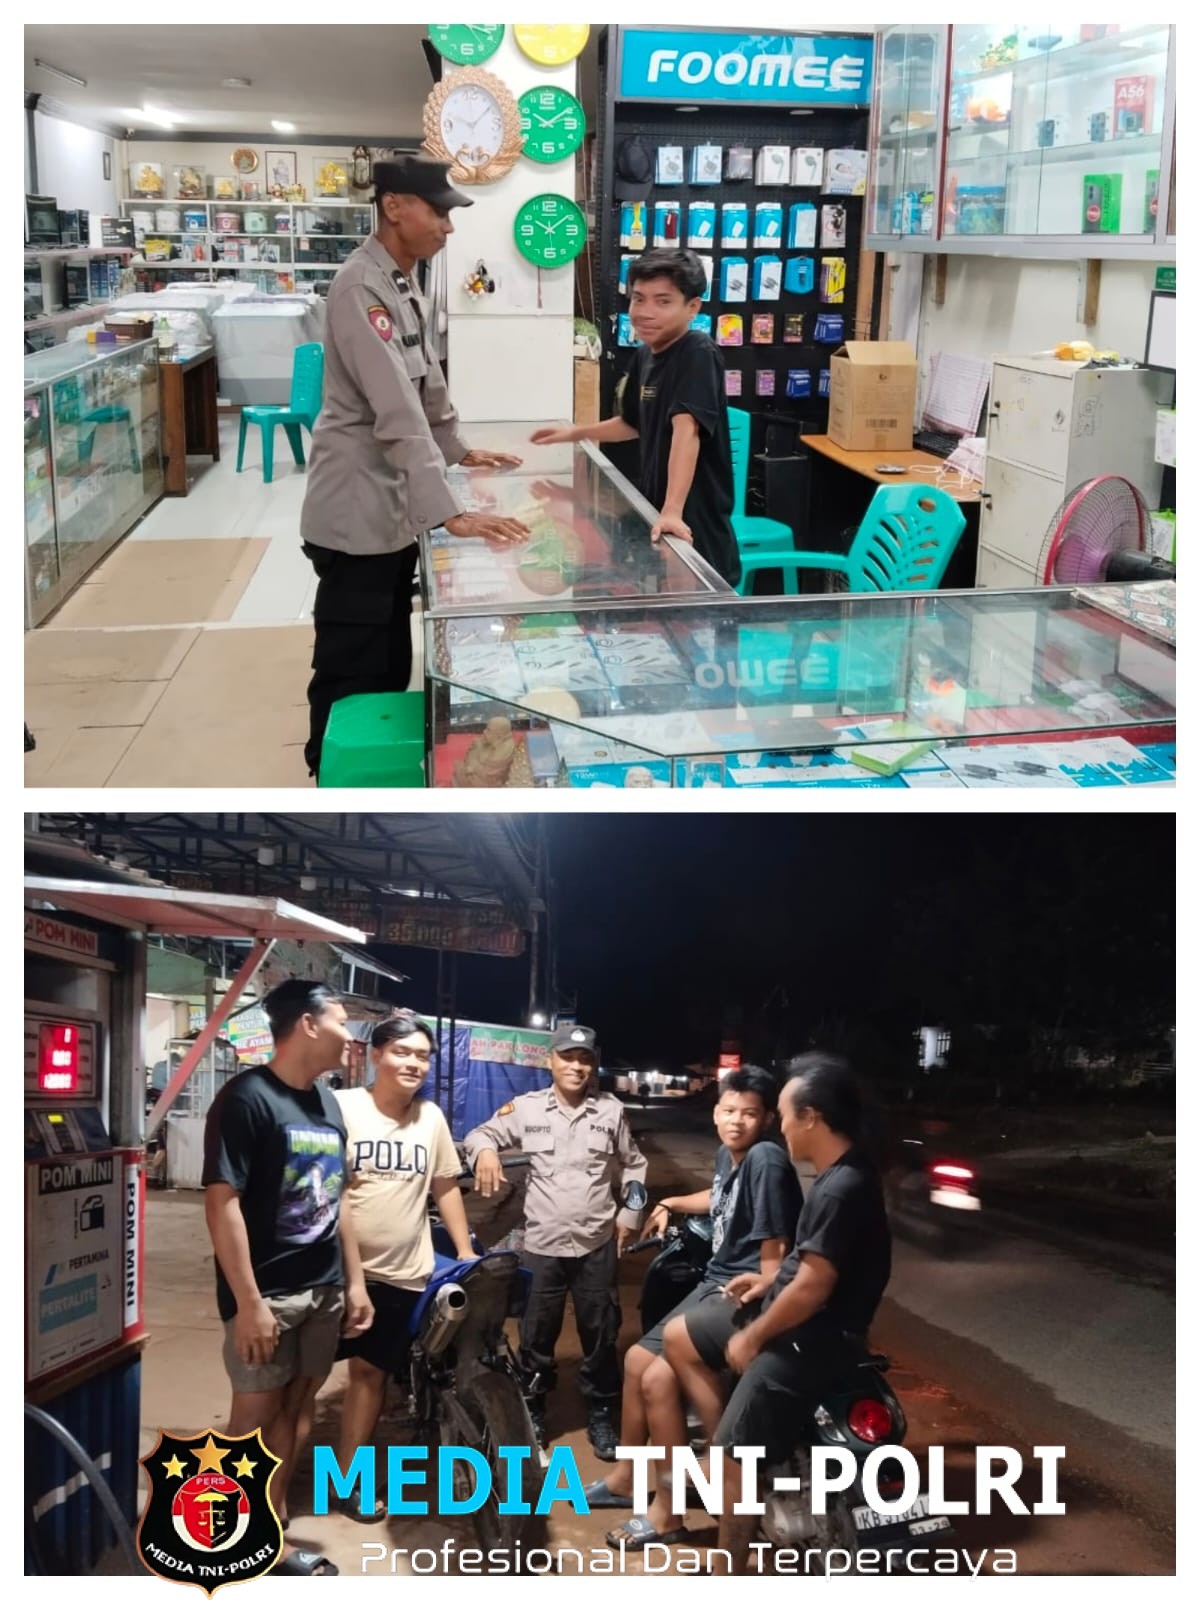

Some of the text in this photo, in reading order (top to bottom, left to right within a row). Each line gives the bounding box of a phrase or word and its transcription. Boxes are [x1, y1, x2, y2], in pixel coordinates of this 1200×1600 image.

[460, 43, 474, 56] 6
[648, 49, 864, 90] FOOMEE
[540, 93, 555, 105] 12
[564, 118, 578, 130] 3
[542, 142, 555, 154] 6
[542, 200, 557, 212] 12
[520, 224, 534, 236] 9
[565, 224, 578, 236] 3
[544, 247, 557, 259] 6
[36, 918, 66, 943] POM
[352, 1140, 427, 1175] POLO
[41, 1159, 113, 1191] POM MINI
[126, 1182, 136, 1307] POM MINI
